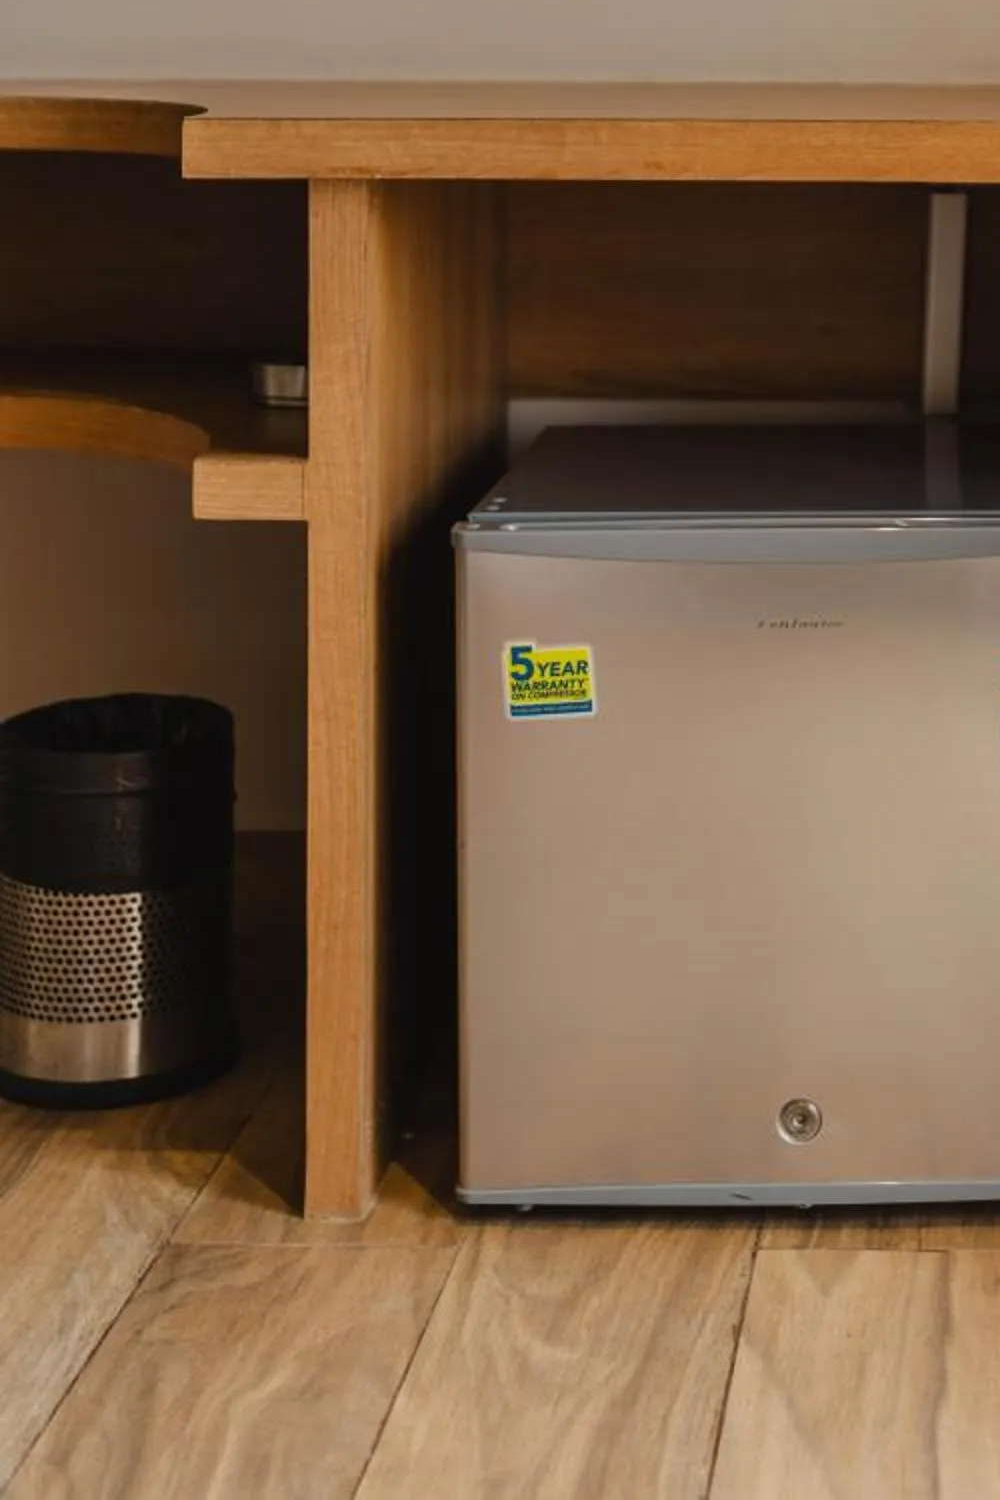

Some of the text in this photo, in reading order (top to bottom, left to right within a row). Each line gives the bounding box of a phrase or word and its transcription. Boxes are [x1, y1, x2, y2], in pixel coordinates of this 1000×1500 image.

[511, 645, 589, 681] 5 YEAR
[511, 678, 585, 693] WARRANTY
